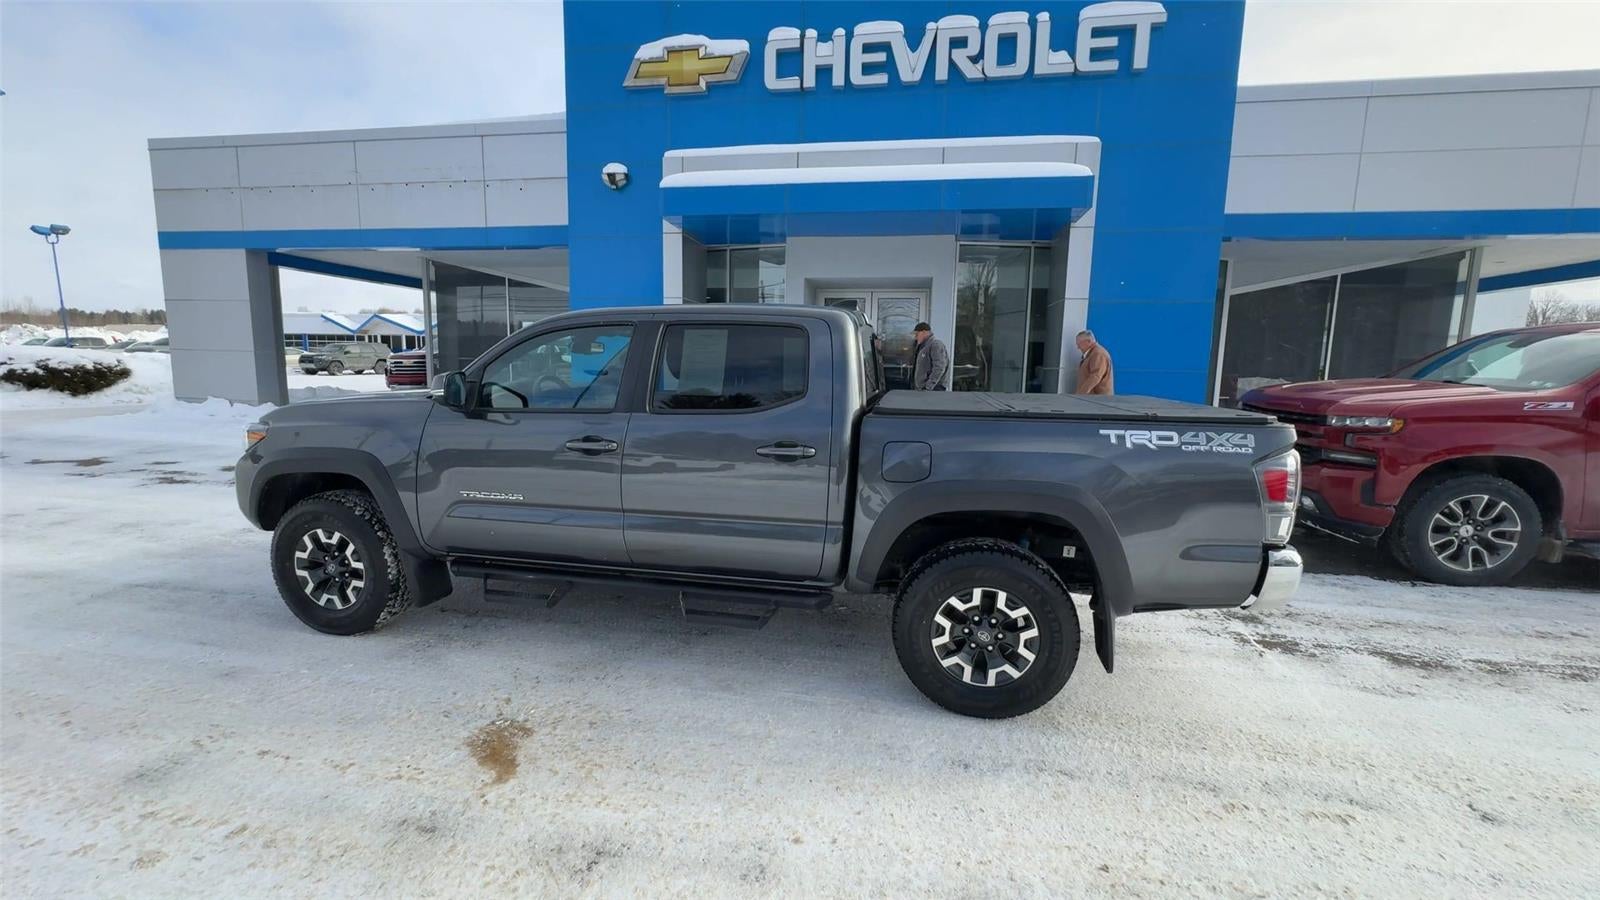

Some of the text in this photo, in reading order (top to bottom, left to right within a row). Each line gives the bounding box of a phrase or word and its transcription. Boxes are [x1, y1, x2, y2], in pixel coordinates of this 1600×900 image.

[763, 10, 1169, 93] CHEVROLET
[1181, 444, 1254, 454] OFF ROAD
[459, 490, 524, 500] TACOMA
